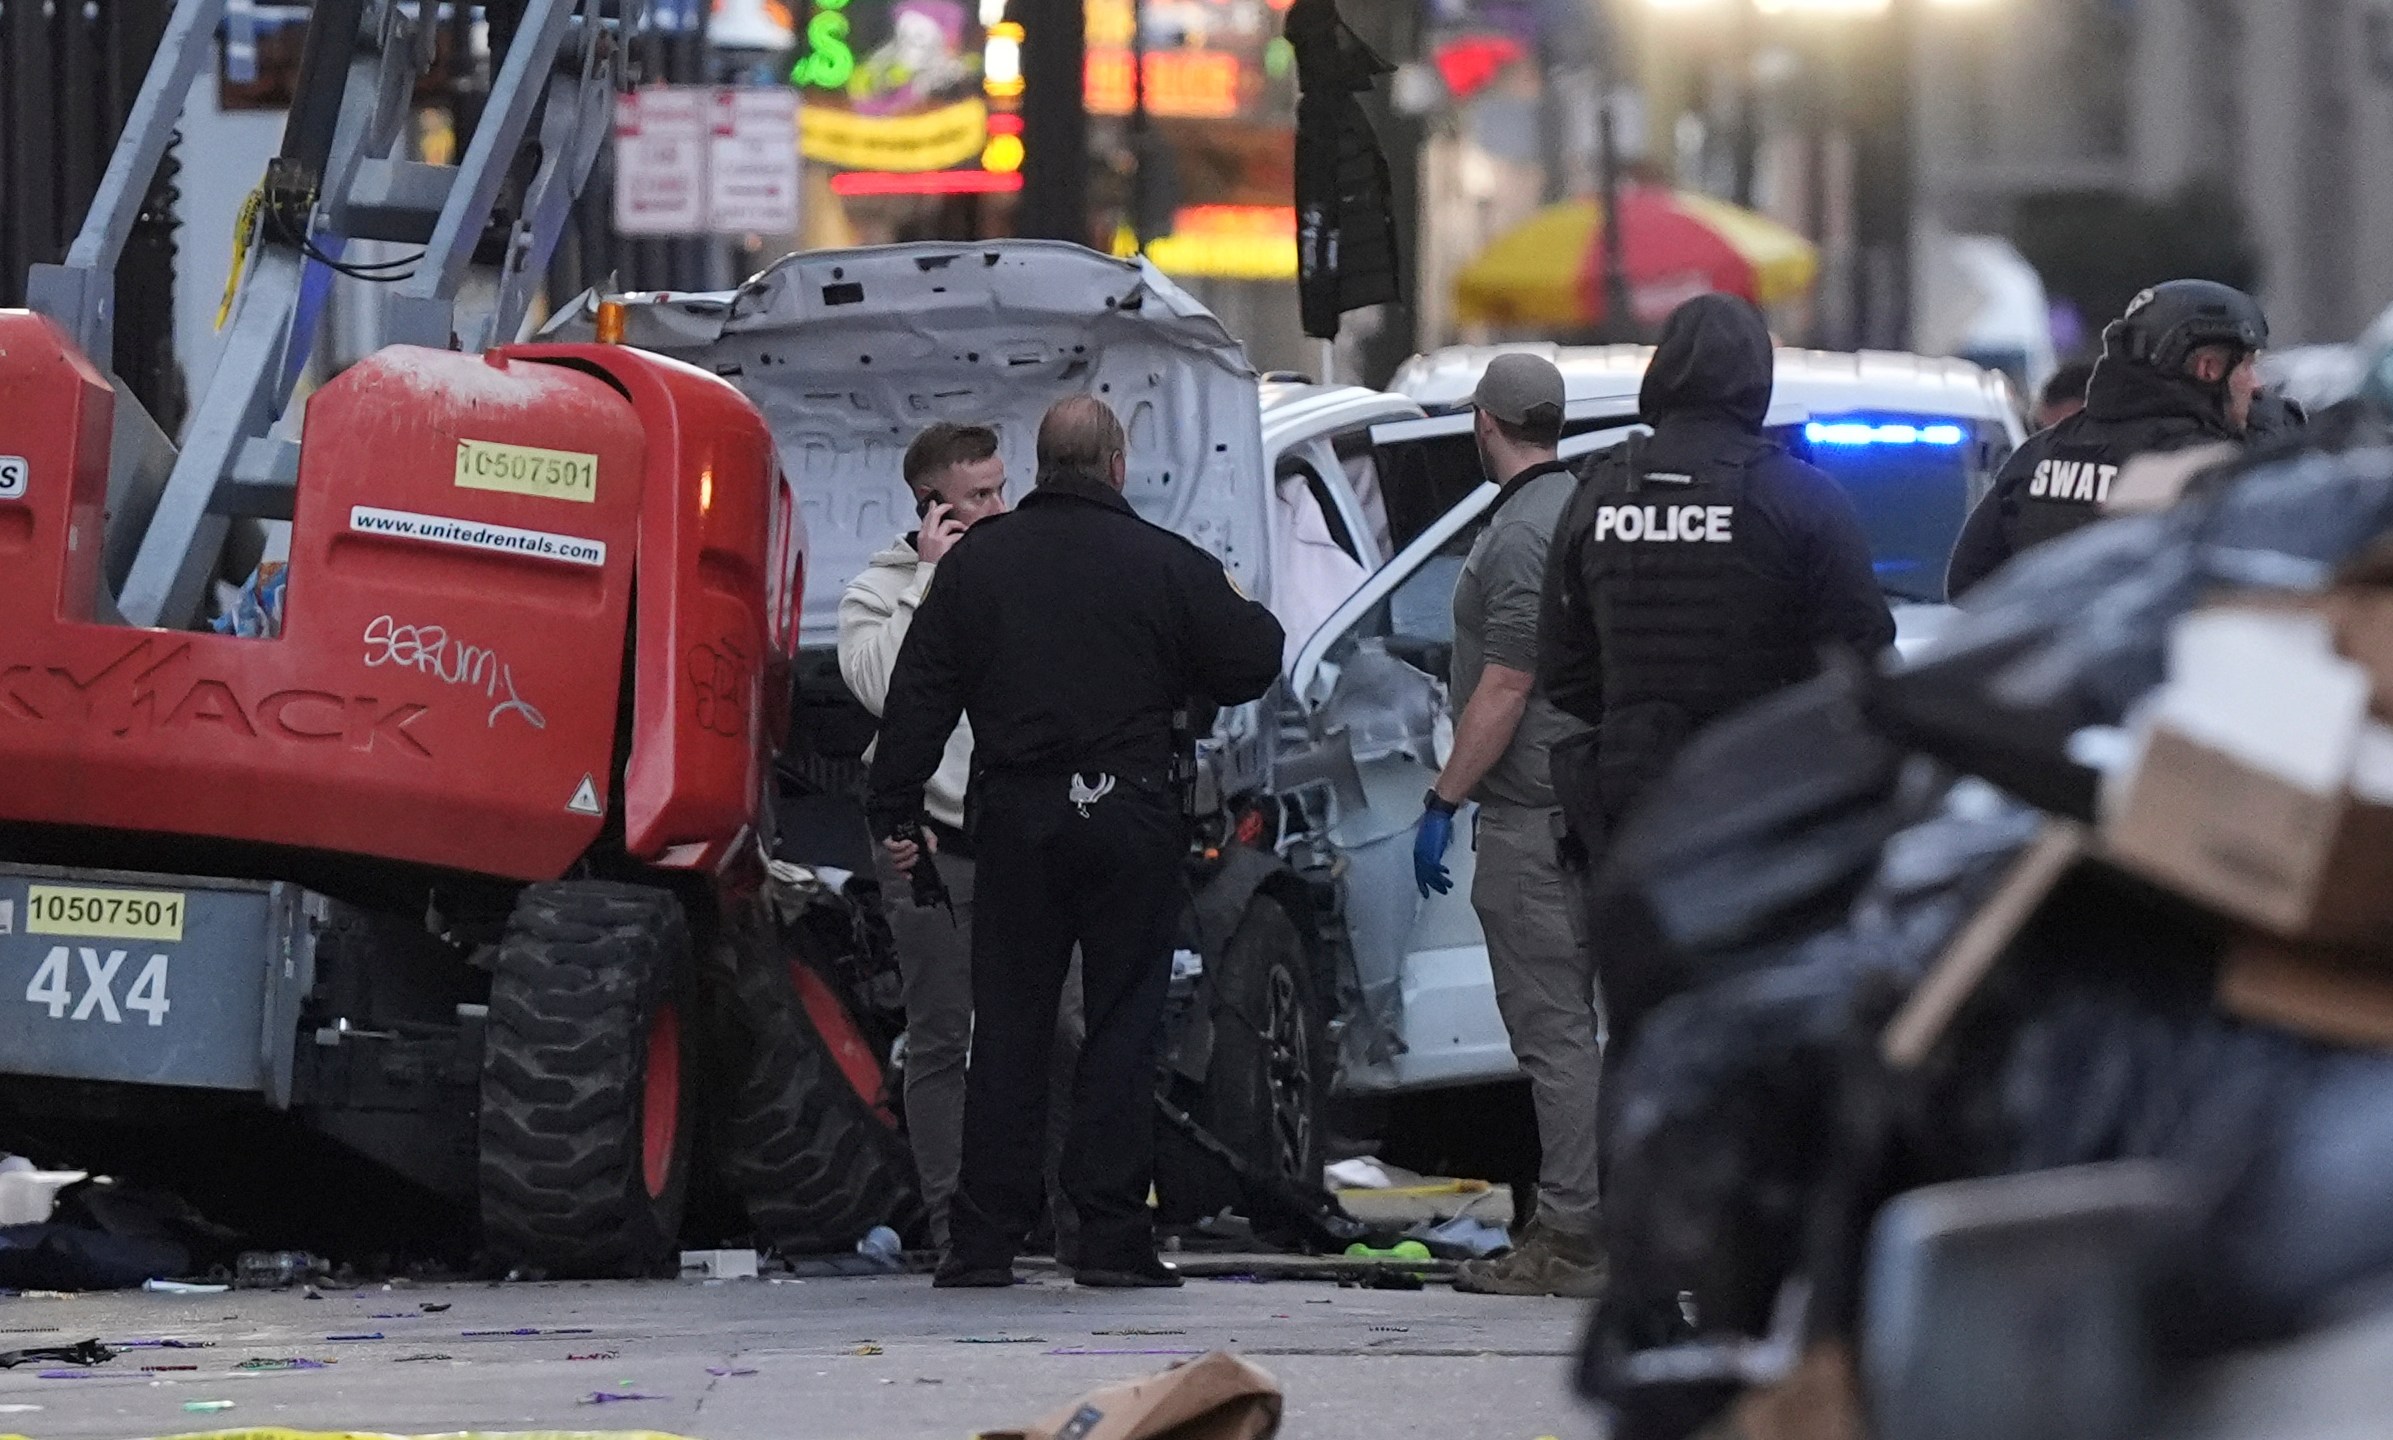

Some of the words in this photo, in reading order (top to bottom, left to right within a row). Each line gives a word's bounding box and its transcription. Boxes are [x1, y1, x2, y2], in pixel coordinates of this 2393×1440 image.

[459, 446, 591, 489] 10507501
[2029, 459, 2118, 502] SWAT
[357, 515, 599, 562] www.unitedrentals.com
[1594, 504, 1734, 542] POLICE
[30, 894, 179, 927] 10507501
[26, 946, 171, 1027] 4X4
